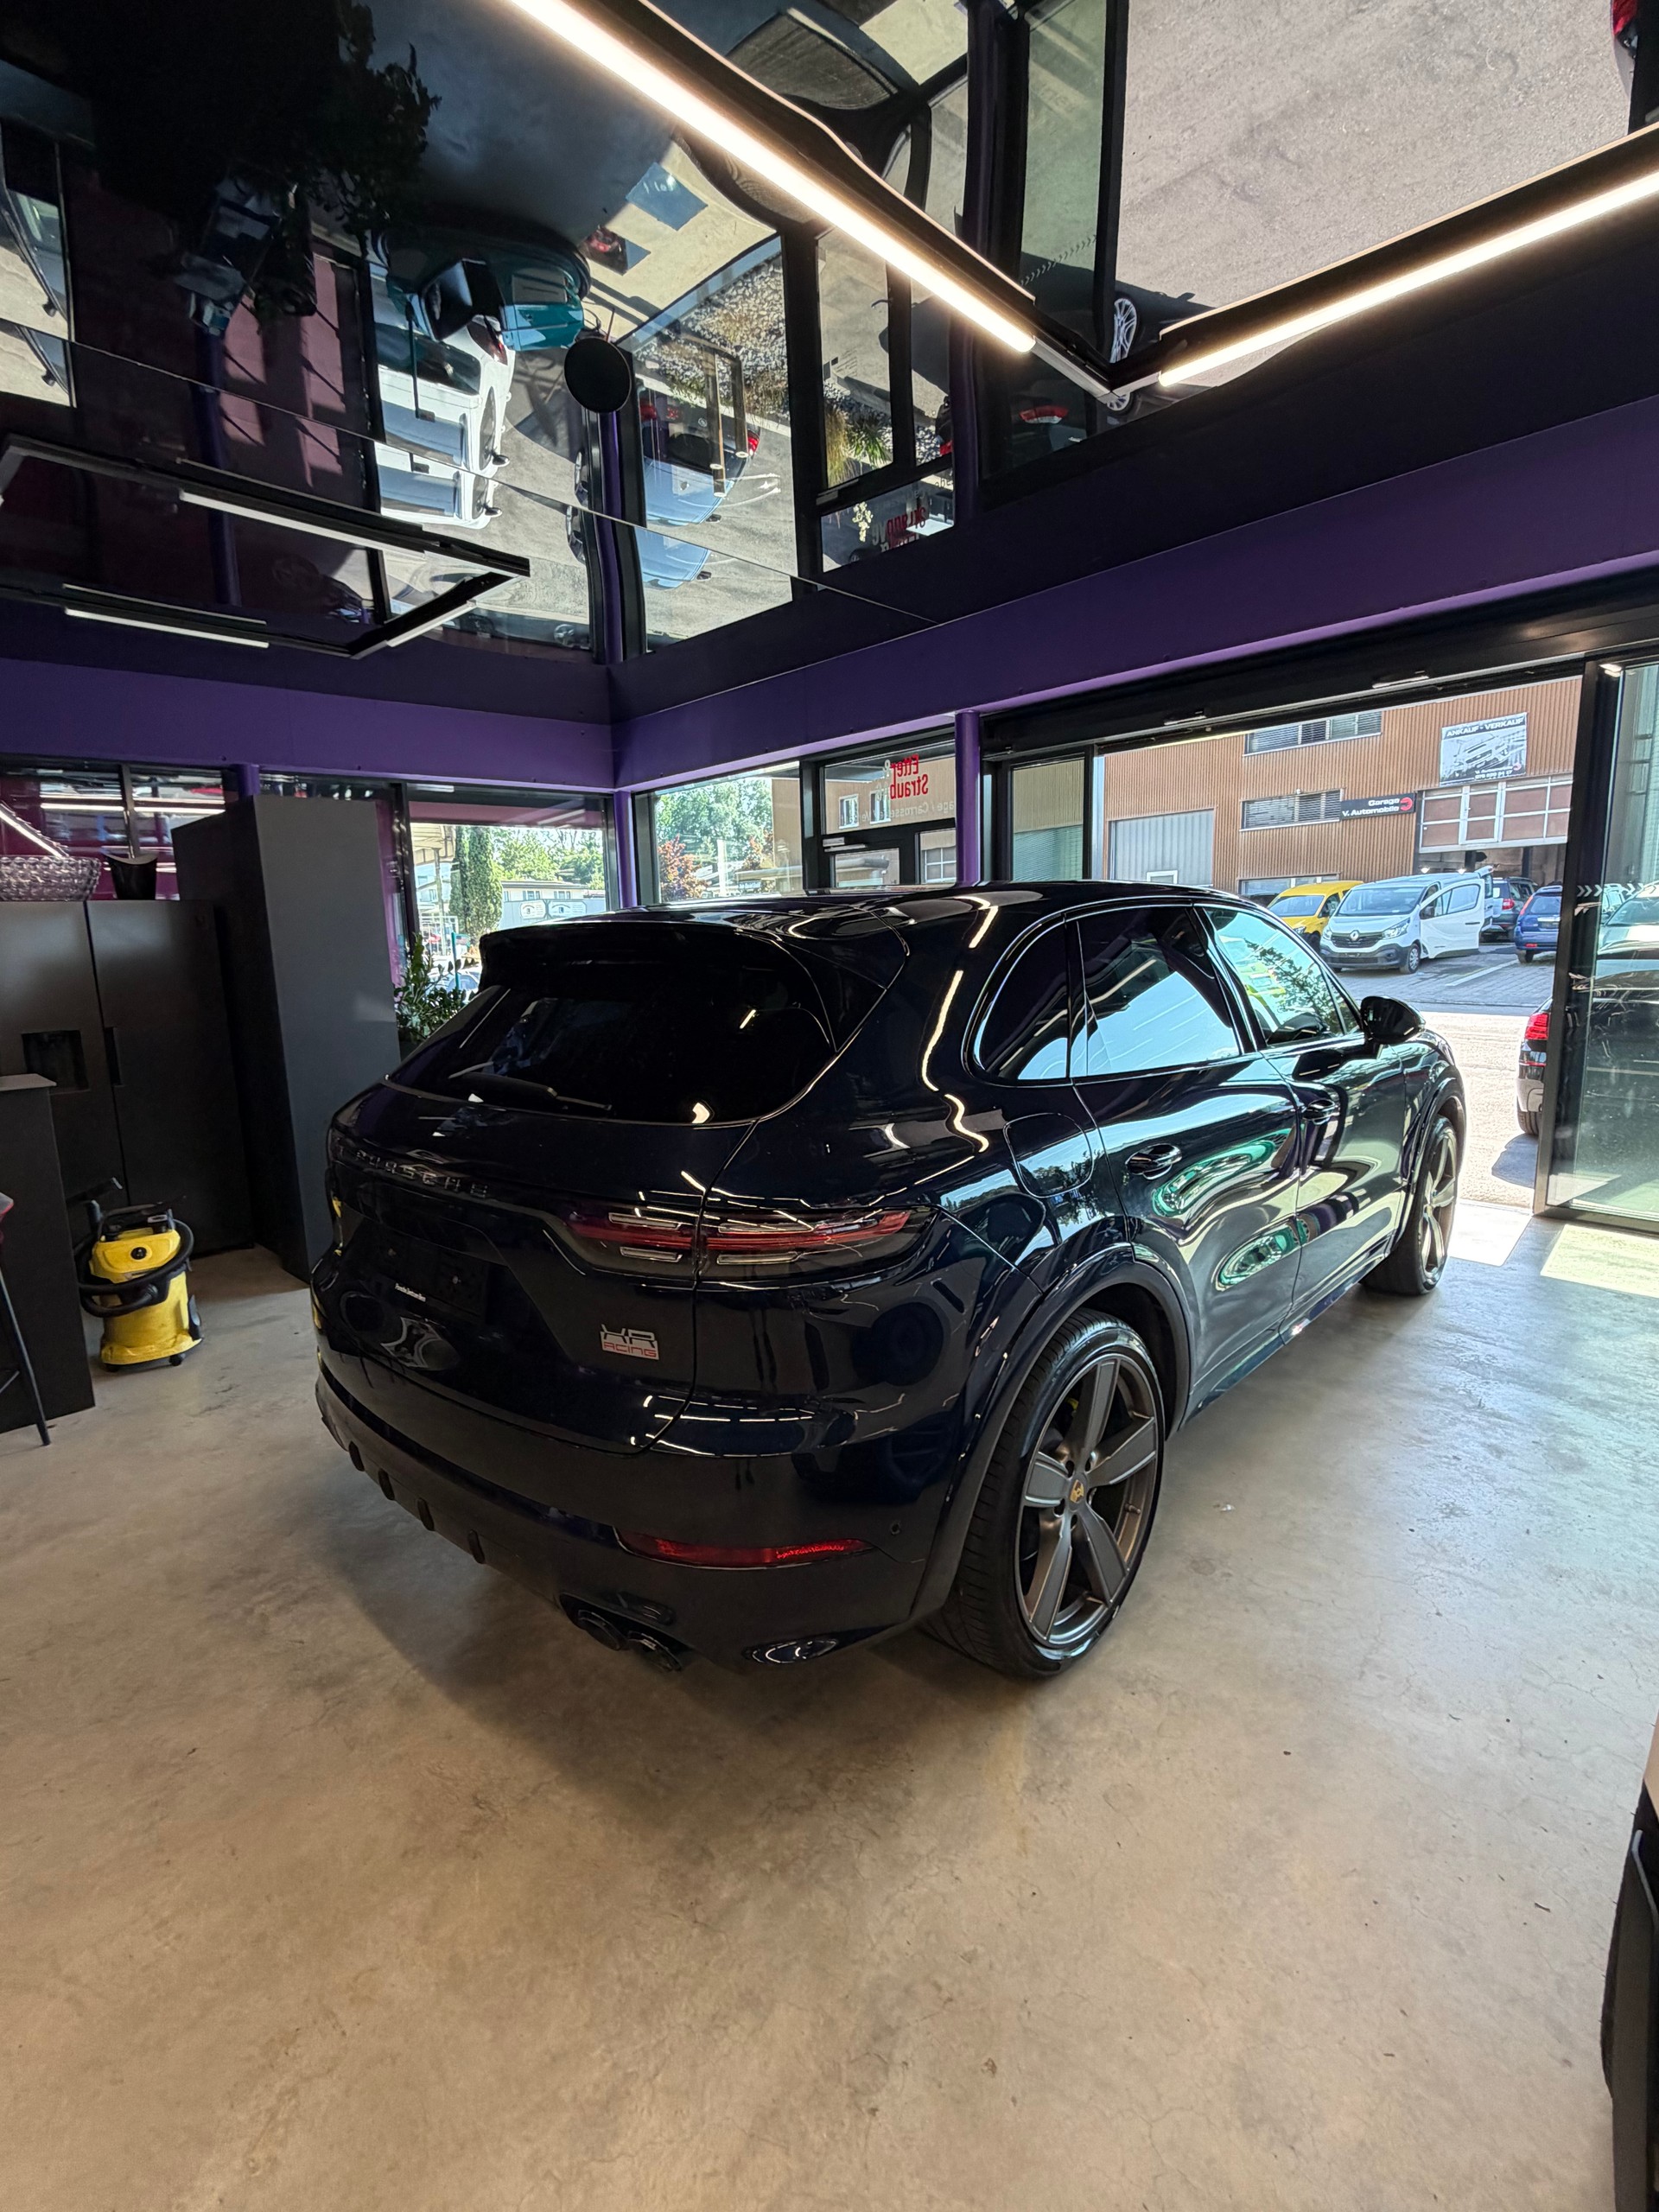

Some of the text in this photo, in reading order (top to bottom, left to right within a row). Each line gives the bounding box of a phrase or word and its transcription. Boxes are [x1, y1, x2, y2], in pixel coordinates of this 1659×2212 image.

[1446, 726, 1479, 737] ANKAUF
[1484, 717, 1523, 730] VERKAUF
[1368, 798, 1400, 806] Garage
[1351, 806, 1400, 816] Automobile
